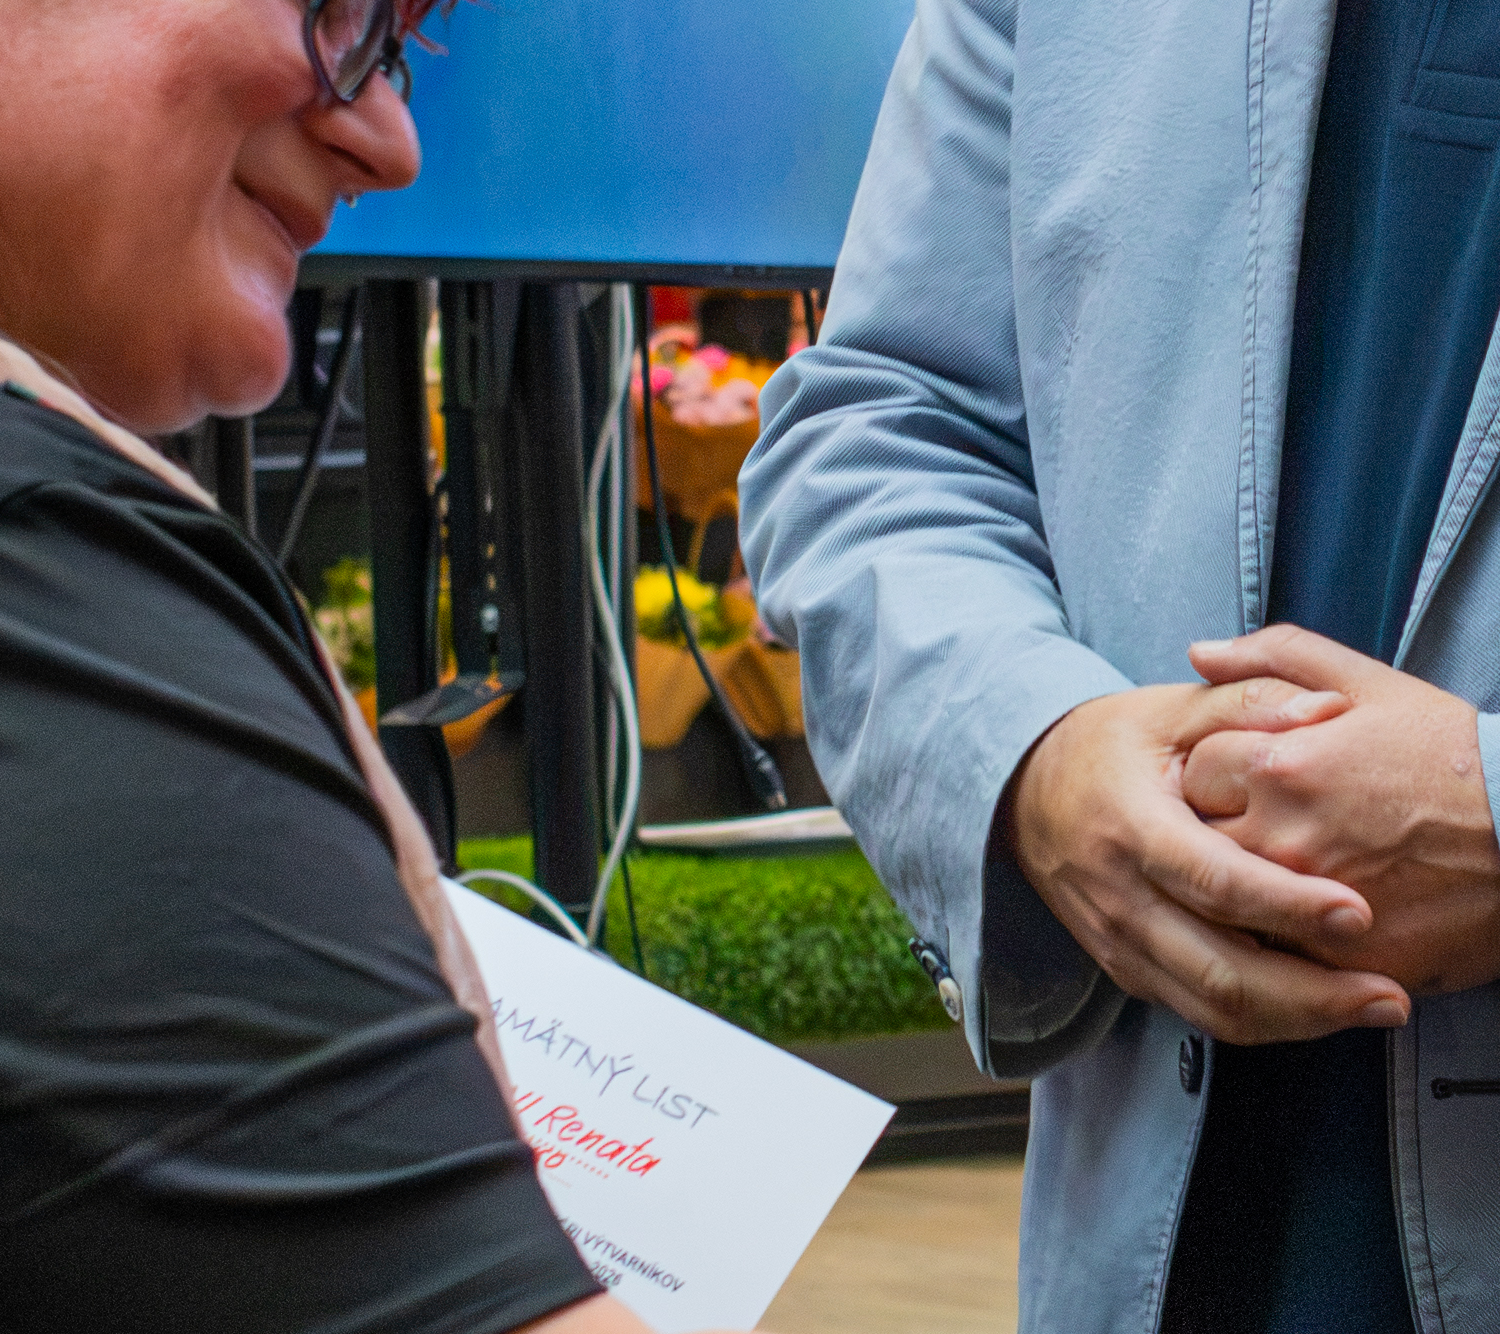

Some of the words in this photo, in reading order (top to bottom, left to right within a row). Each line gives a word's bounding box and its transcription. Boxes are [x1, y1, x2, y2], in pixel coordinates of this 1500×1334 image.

[491, 997, 635, 1097] AMÄTNÝ
[632, 1075, 720, 1129] LIST
[533, 1105, 662, 1178] Renata
